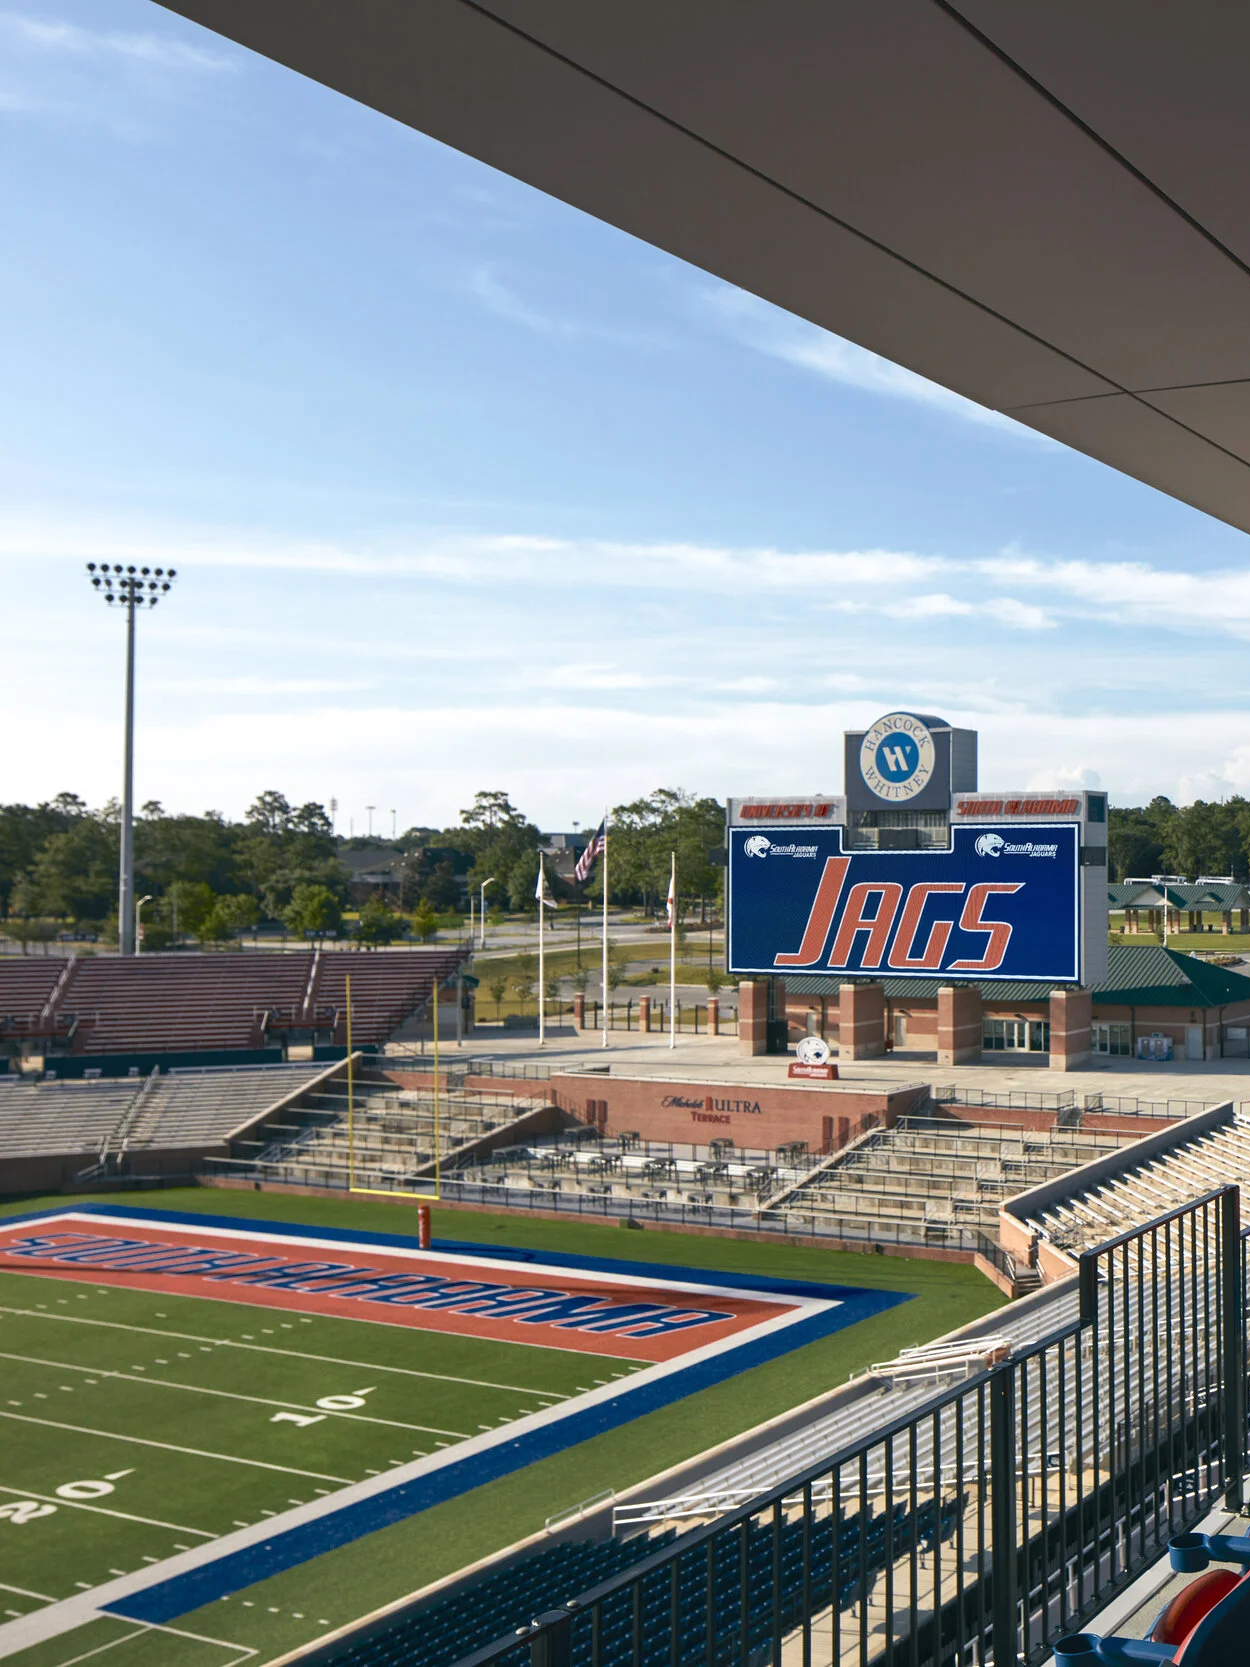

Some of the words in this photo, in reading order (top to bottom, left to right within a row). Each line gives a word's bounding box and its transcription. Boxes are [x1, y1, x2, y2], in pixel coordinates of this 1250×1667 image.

[865, 717, 930, 751] HANCOCK
[865, 764, 929, 798] WHITNEY
[740, 804, 813, 818] UNIVERSITY
[814, 803, 834, 817] OF
[956, 800, 1003, 815] SOUTH
[1003, 799, 1078, 815] ALABAMA
[773, 856, 1026, 971] JAGS
[690, 1111, 731, 1124] TERRACE
[714, 1099, 762, 1114] ULTRA
[0, 1232, 288, 1276] SOUTH
[203, 1261, 737, 1339] ALABAMA
[270, 1395, 366, 1426] 10
[0, 1480, 116, 1524] 20
